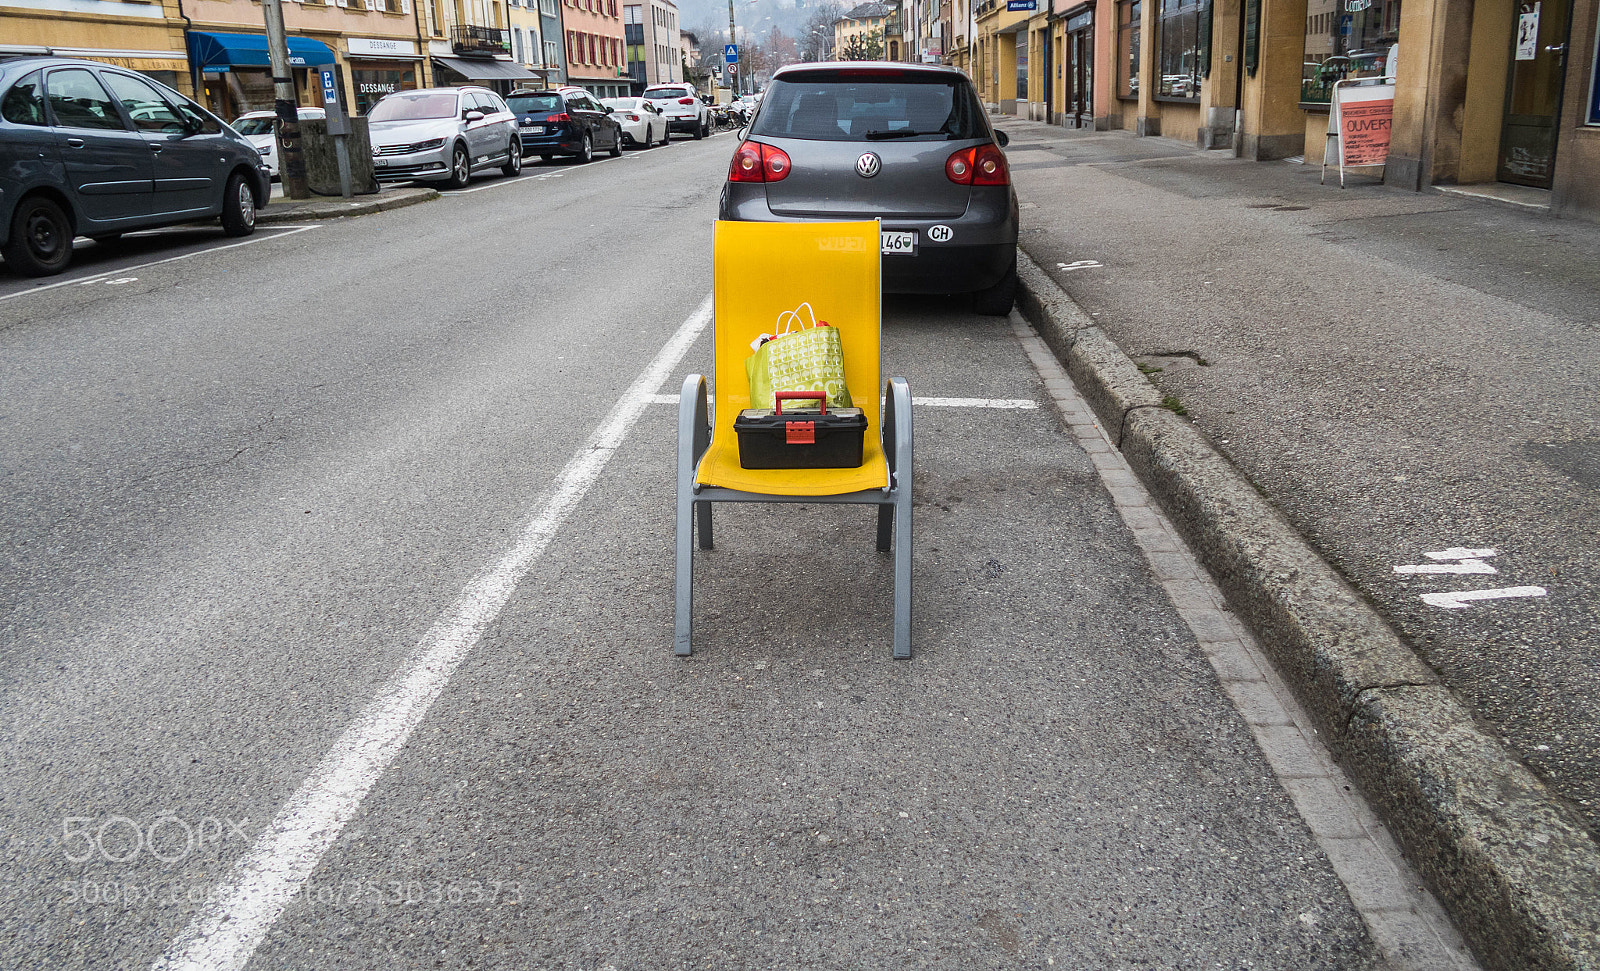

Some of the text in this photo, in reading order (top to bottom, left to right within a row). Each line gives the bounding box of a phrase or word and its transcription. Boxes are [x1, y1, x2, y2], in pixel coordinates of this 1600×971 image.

[369, 41, 397, 50] DESSANGE
[323, 71, 330, 81] P
[360, 83, 395, 93] DESSANGE
[1347, 119, 1392, 132] OUVERT
[931, 227, 949, 240] CH
